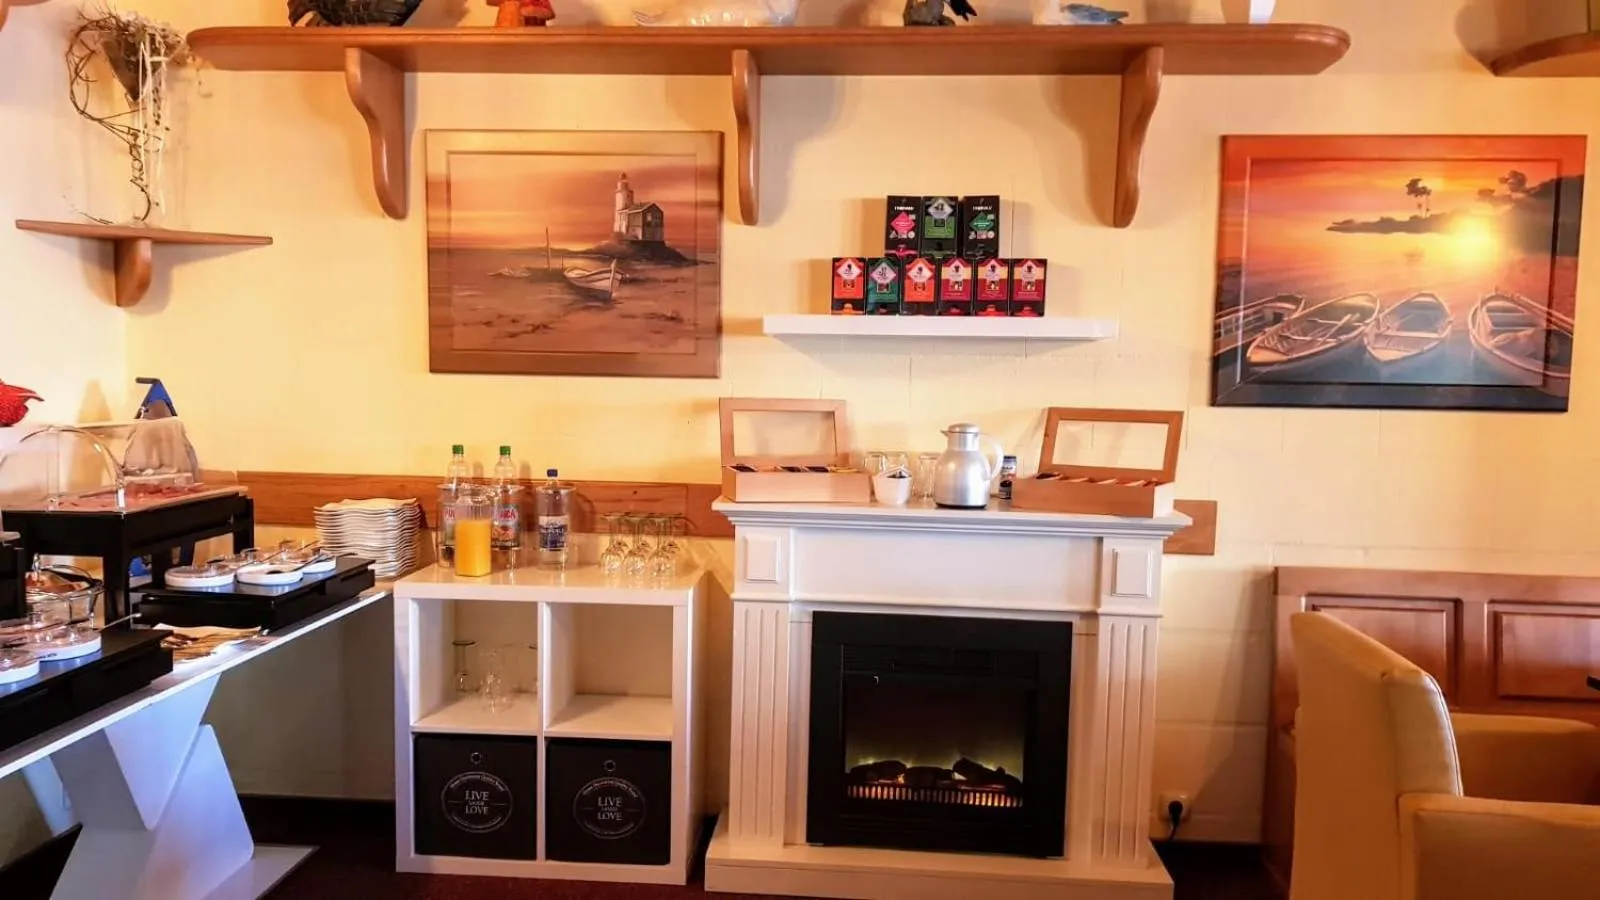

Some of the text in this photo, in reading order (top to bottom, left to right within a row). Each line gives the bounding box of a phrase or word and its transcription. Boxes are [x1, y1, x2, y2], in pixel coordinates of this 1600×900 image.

[466, 791, 489, 801] LIVE
[598, 797, 623, 807] LIVE
[466, 806, 489, 815] LOVE
[598, 812, 623, 821] LOVE
